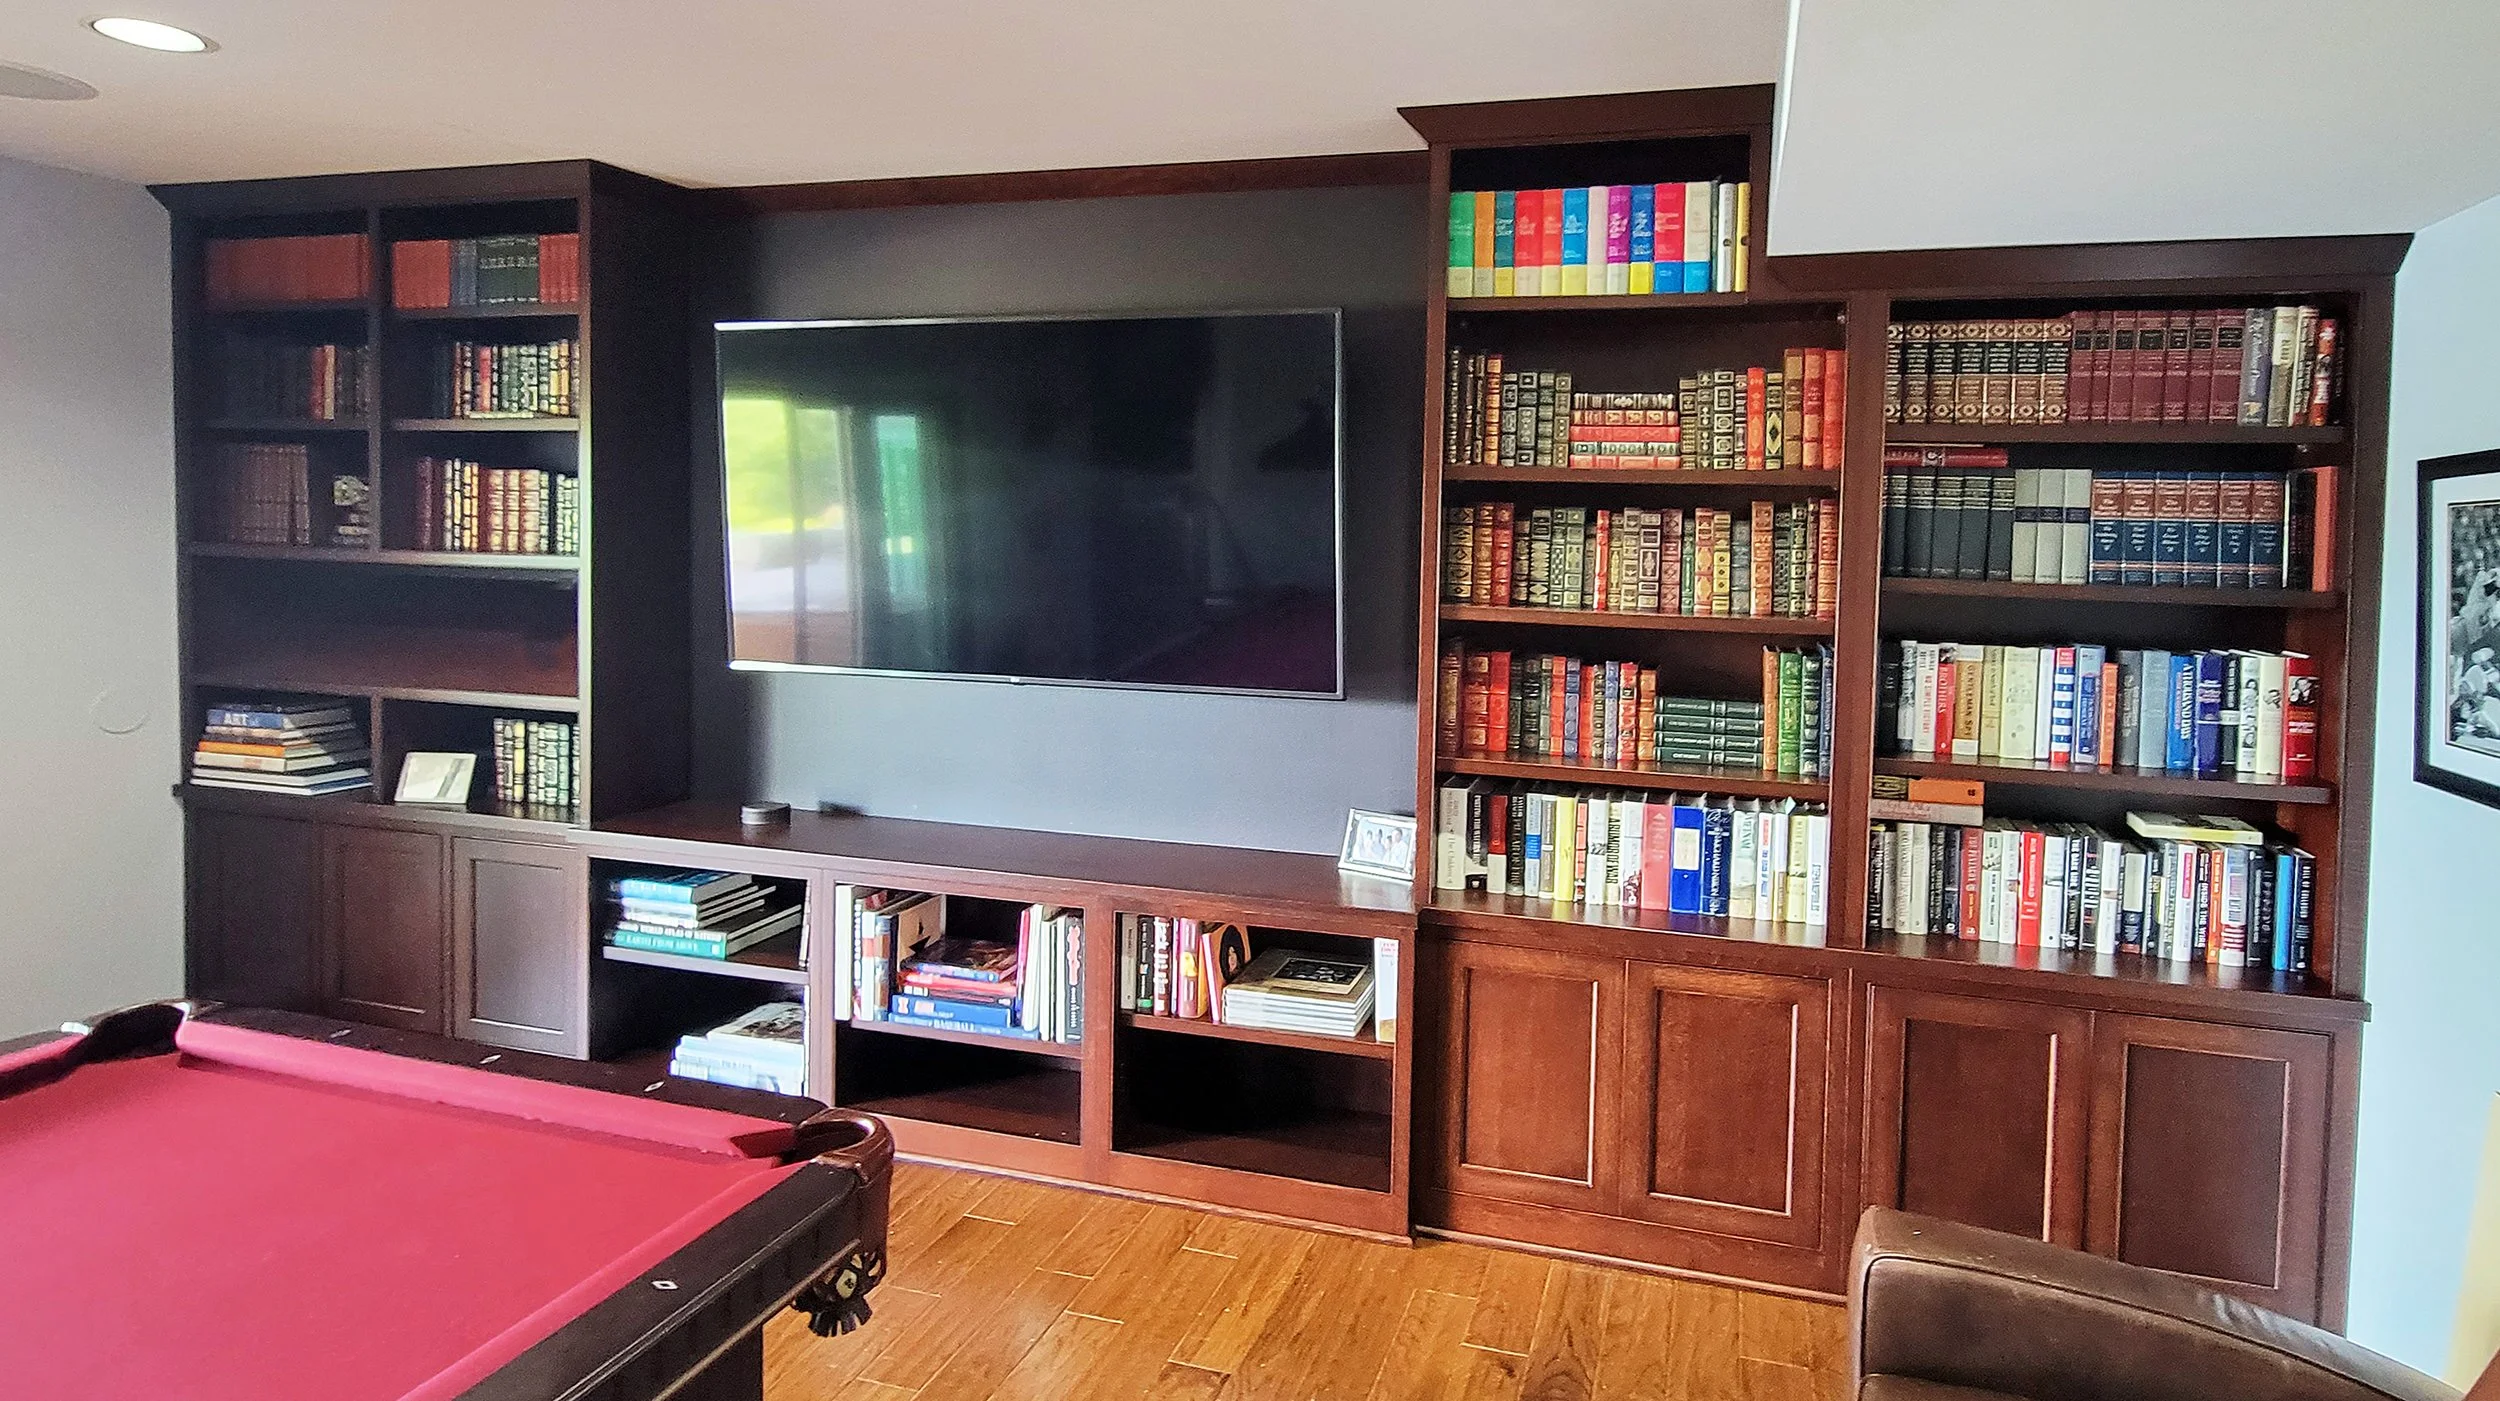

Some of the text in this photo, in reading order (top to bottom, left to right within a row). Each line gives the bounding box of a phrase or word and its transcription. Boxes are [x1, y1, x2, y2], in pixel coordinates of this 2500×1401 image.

[2183, 663, 2195, 671] A
[1923, 685, 1932, 708] SIMPLE
[1938, 667, 1948, 713] BROTHERS
[1965, 665, 1975, 717] GENTLEMAN
[2181, 671, 2194, 719] THOUSAND
[224, 712, 249, 726] ART
[1922, 709, 1931, 734] VICTORY
[1510, 818, 1523, 852] PILLAR
[1606, 824, 1620, 853] RUMOR
[1741, 816, 1754, 849] VIETNAM
[1447, 838, 1457, 877] The Children
[1511, 852, 1522, 865] OF
[1606, 854, 1619, 865] OF
[2069, 838, 2080, 888] THE DARK SIDE
[1605, 864, 1619, 885] WAR
[1711, 872, 1722, 897] NIXON
[2027, 854, 2037, 898] WOODWARD
[2301, 880, 2310, 888] OF
[2199, 882, 2209, 908] INSIDE
[2199, 910, 2208, 925] THE
[2197, 926, 2207, 948] WIRE
[933, 1019, 976, 1032] BASEBALL
